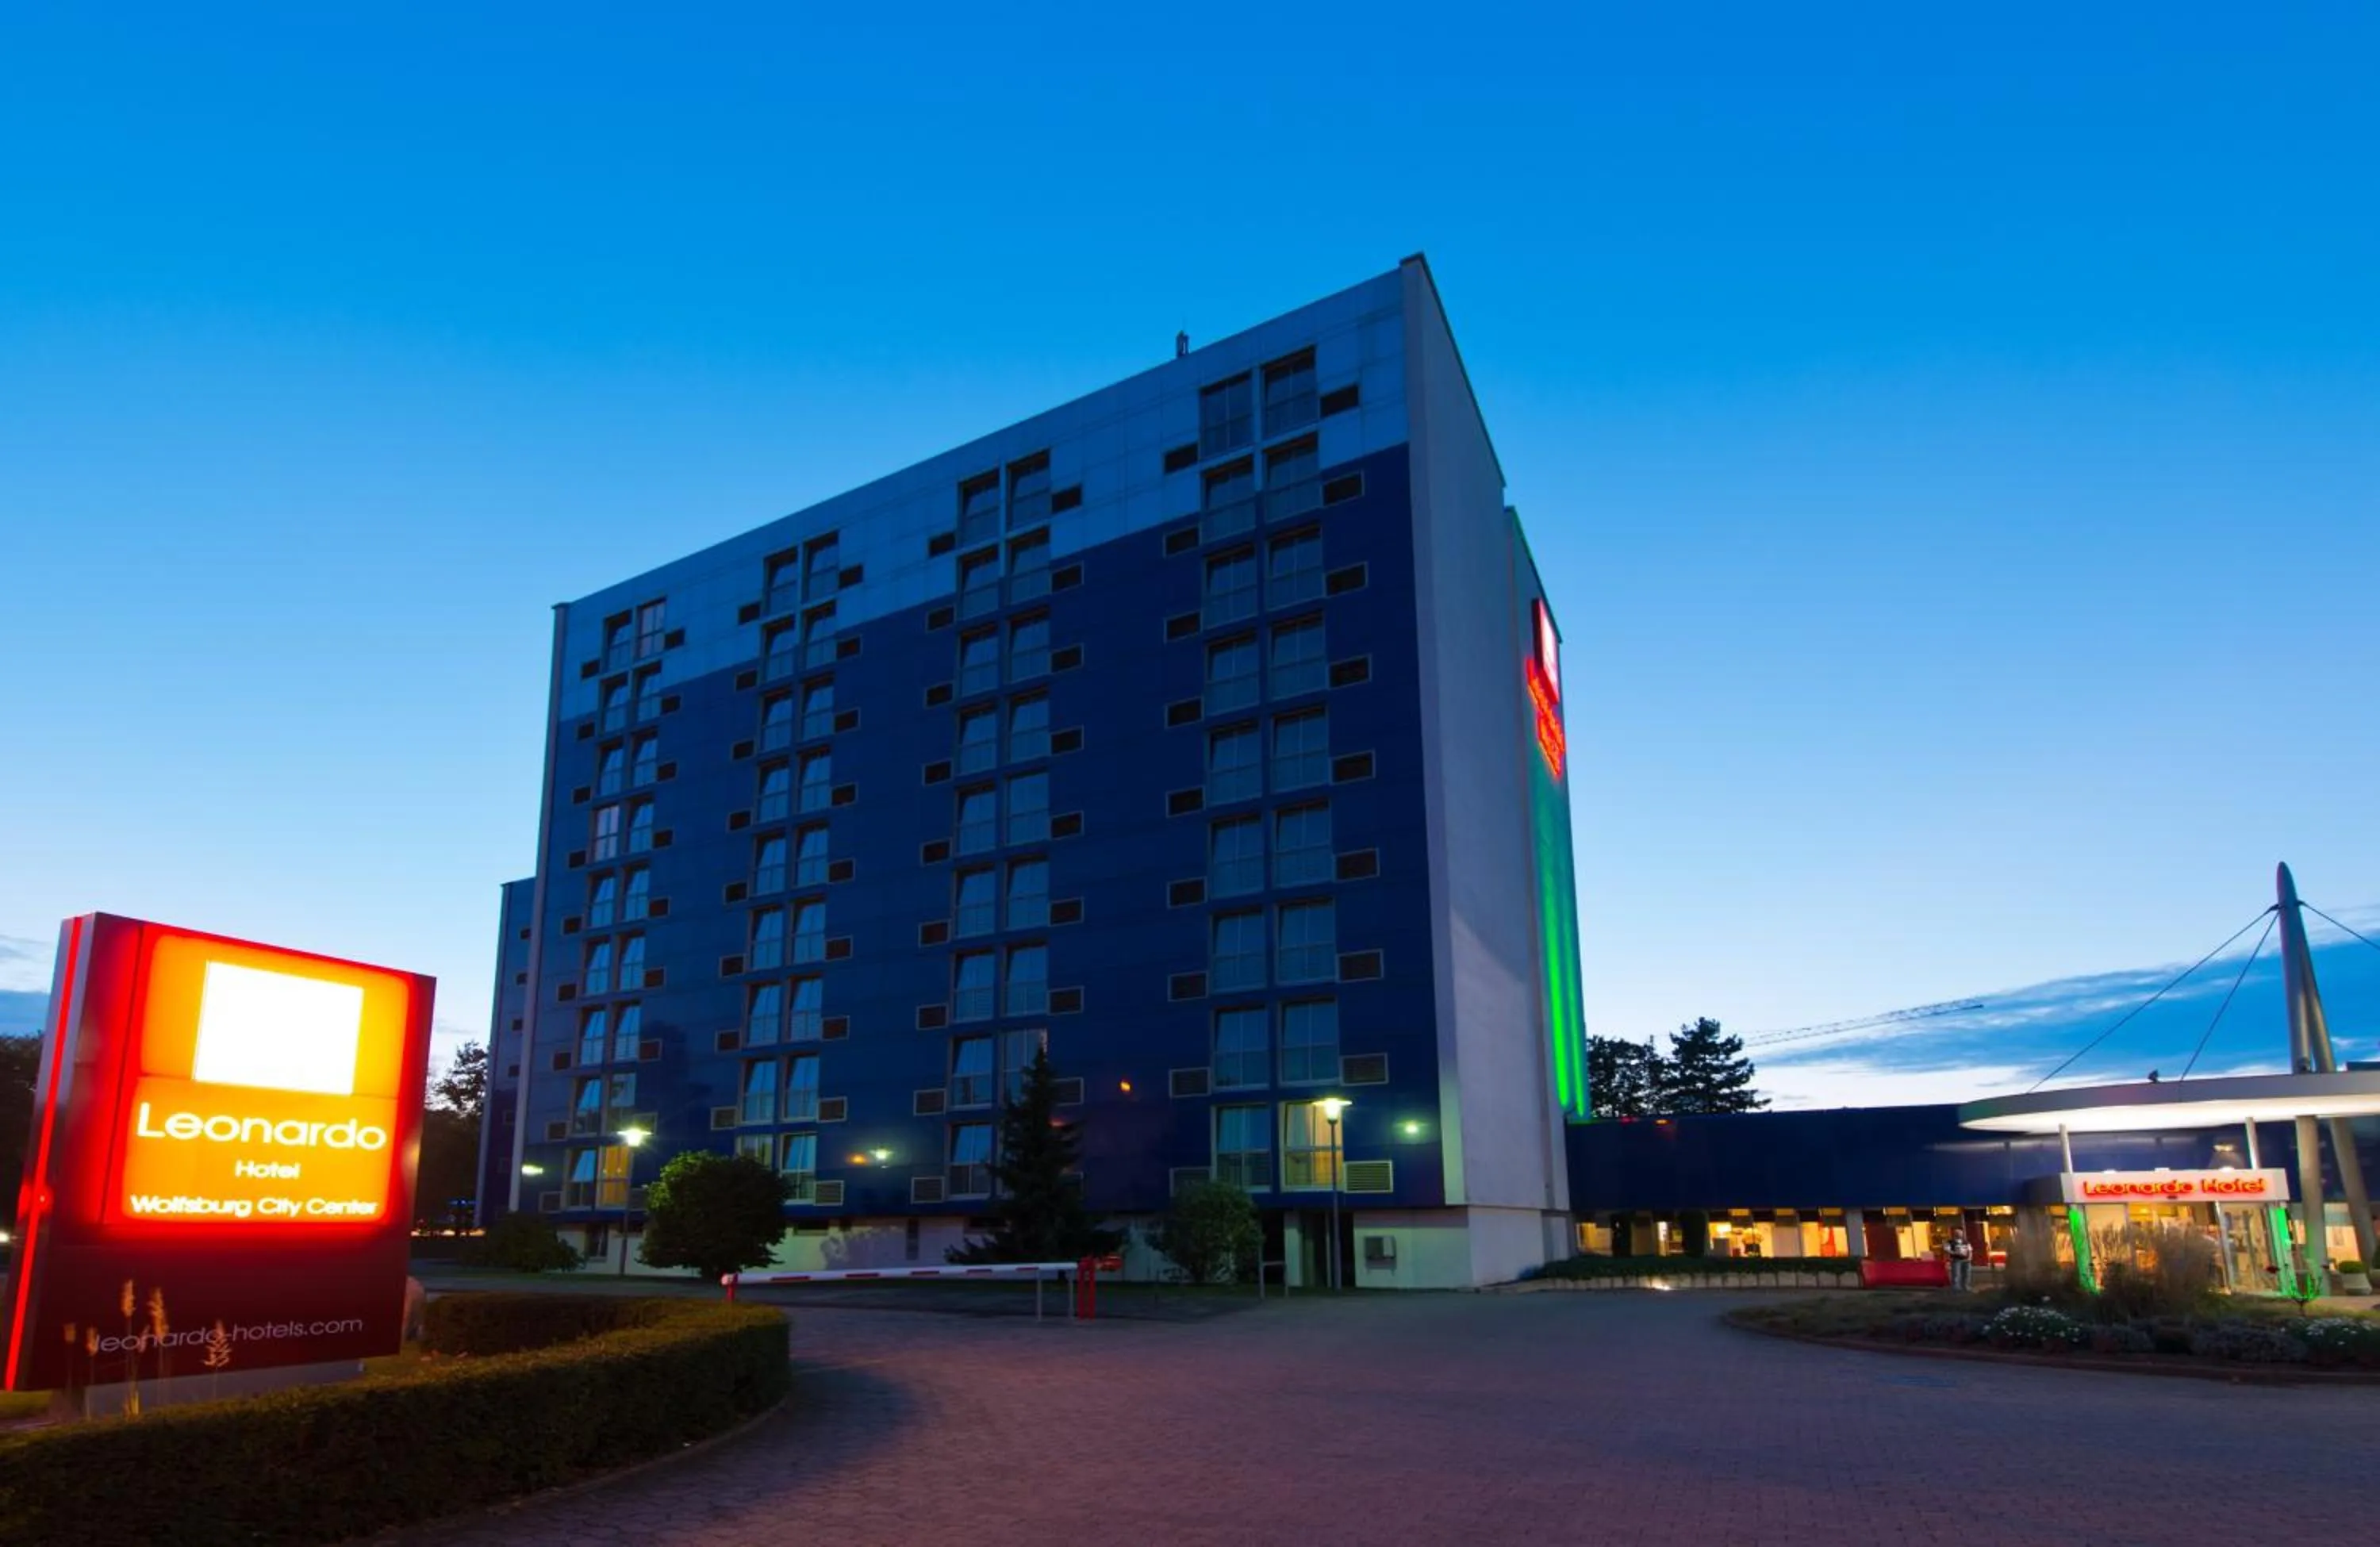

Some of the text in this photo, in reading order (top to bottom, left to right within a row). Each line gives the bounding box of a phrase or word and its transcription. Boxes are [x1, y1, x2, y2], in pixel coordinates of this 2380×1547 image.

[136, 1102, 386, 1150] Leonardo
[235, 1161, 300, 1179] Hotel
[2082, 1177, 2267, 1196] Leonardo Hotel
[130, 1195, 378, 1218] Wolfsburg City Center
